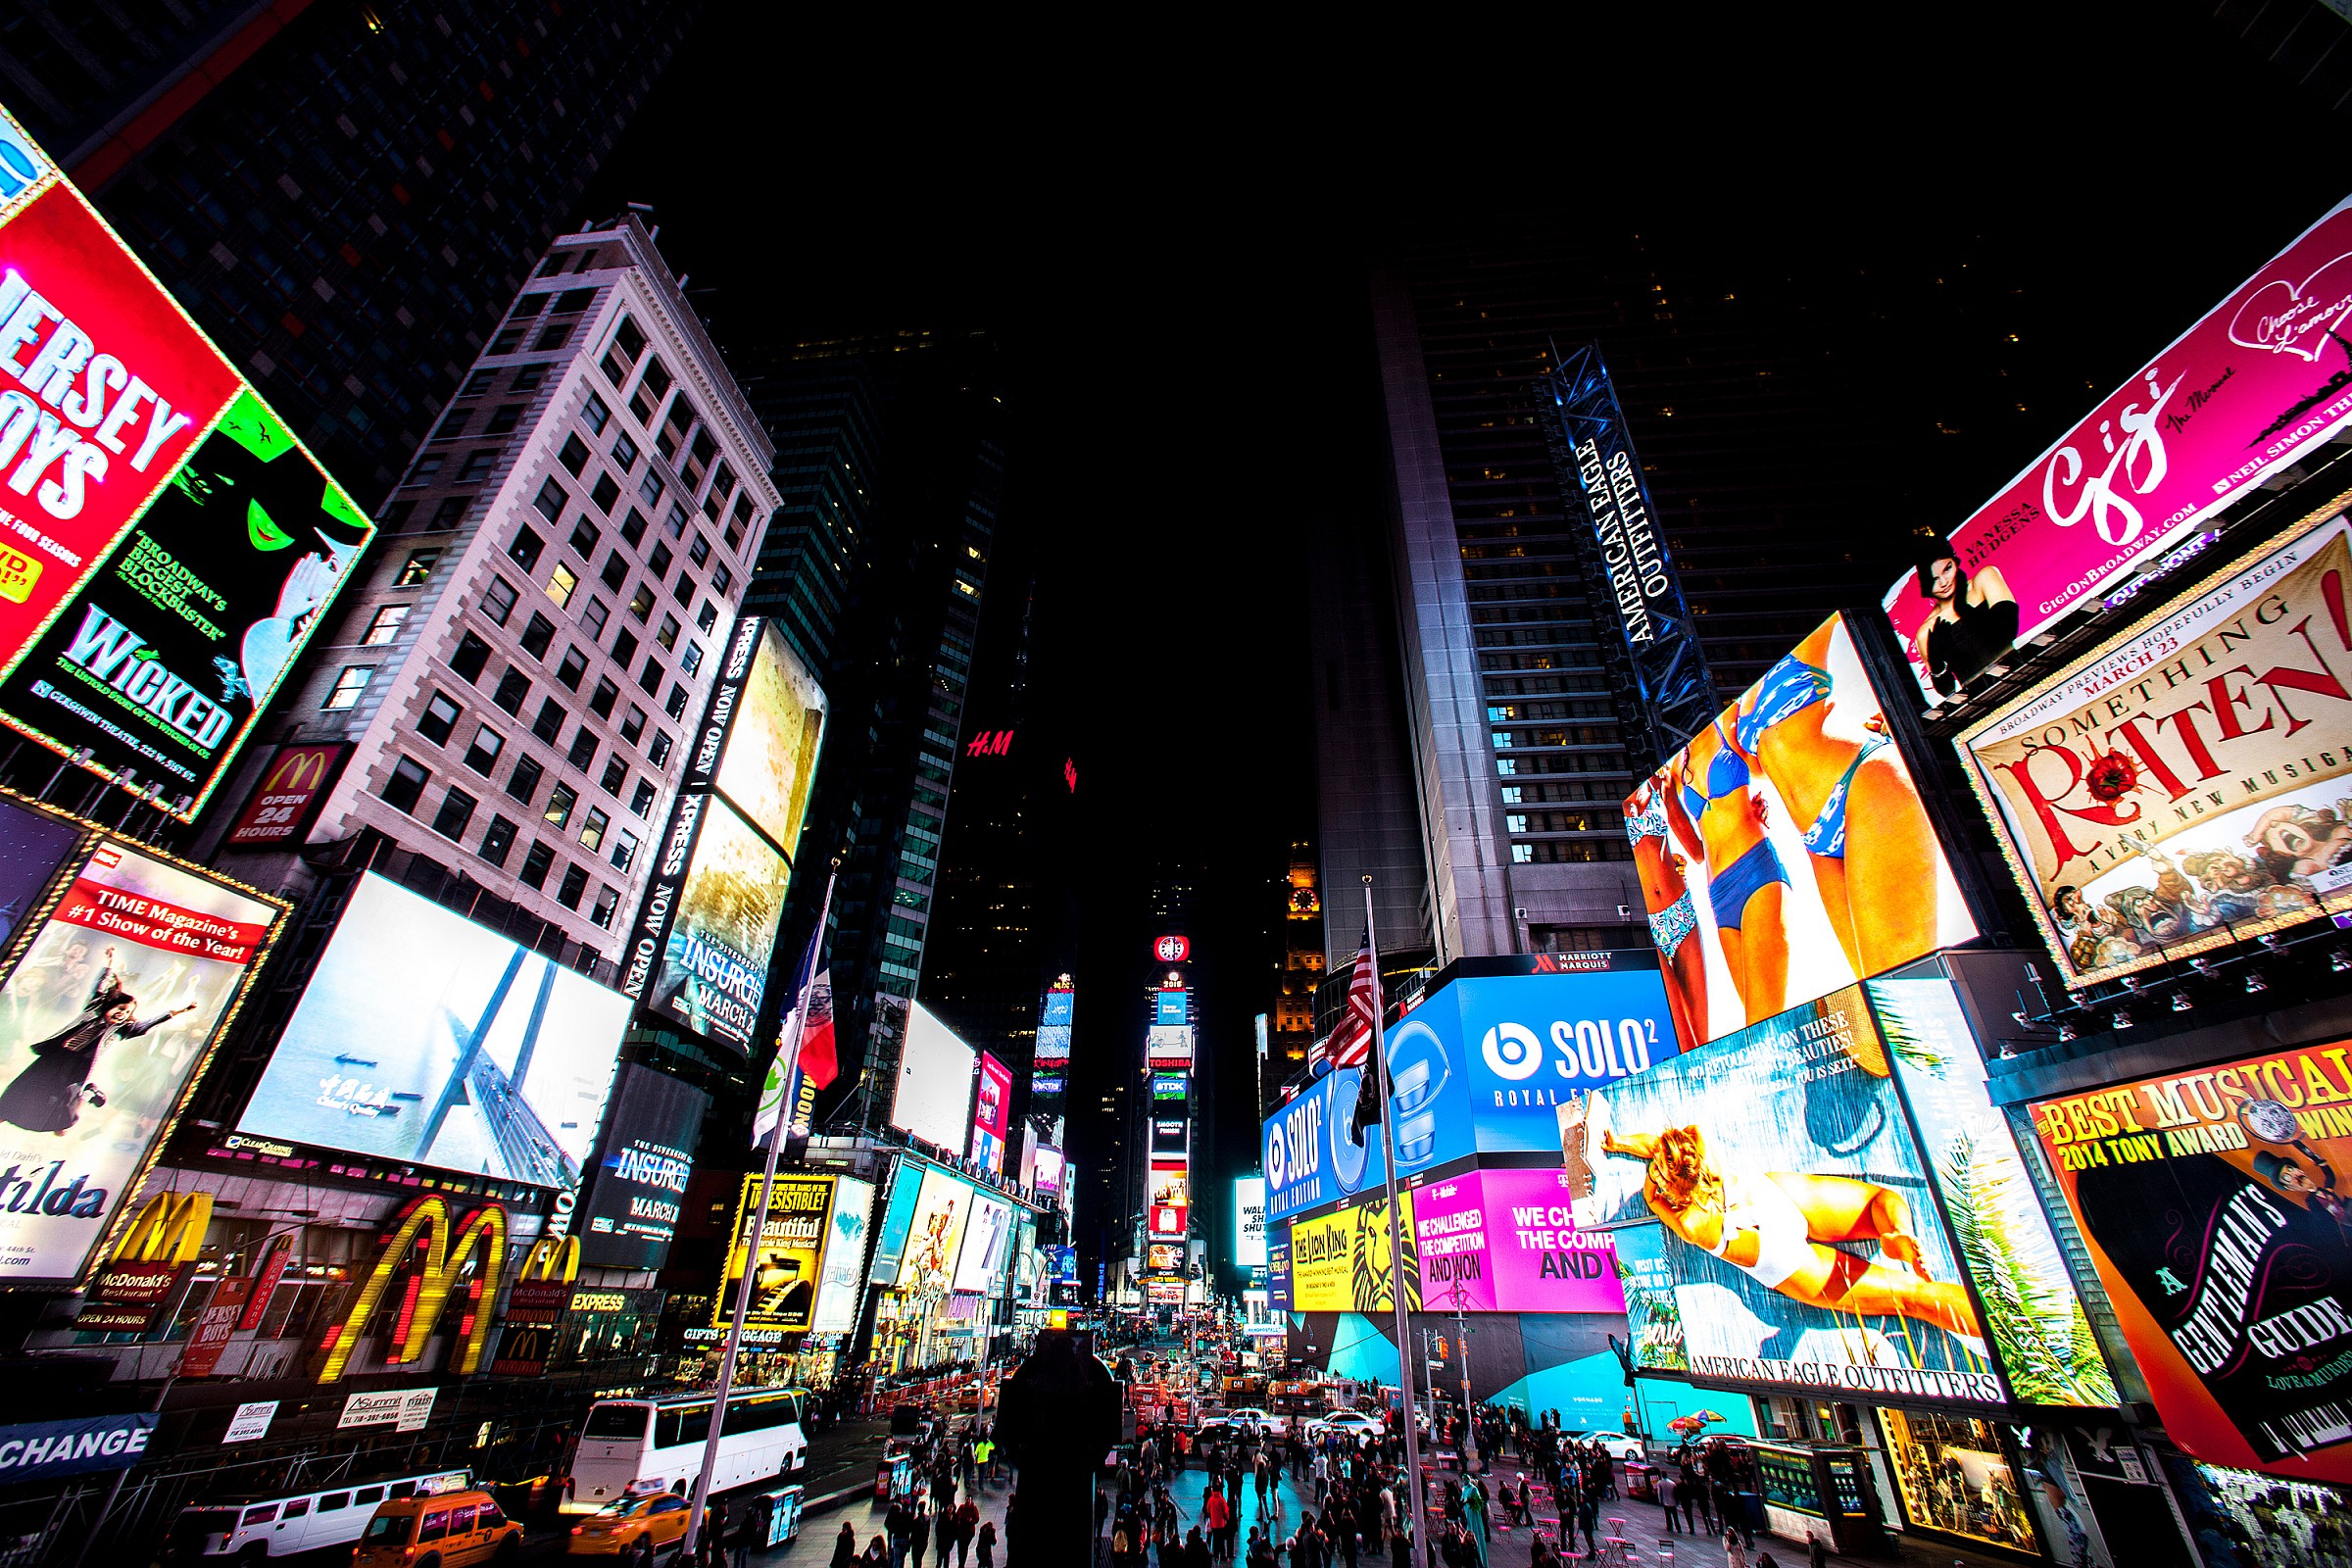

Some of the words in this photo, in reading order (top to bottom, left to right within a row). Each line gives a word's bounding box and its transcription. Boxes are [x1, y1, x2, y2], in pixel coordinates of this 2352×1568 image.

[2256, 296, 2320, 343] Choose
[2165, 413, 2192, 434] The
[2229, 457, 2269, 484] NEIL
[2267, 416, 2325, 458] SIMON
[1575, 438, 1612, 514] EAGLE
[1606, 451, 1668, 599] OUTFITTERS
[1965, 502, 2033, 556] VANESSA
[1968, 507, 2040, 568] HUDGENS
[37, 535, 81, 568] SEASONS
[127, 546, 193, 599] BIGGEST
[1595, 510, 1653, 644] AMERICAN
[2000, 692, 2063, 736] BROADWAY
[2067, 648, 2138, 694] PREVIEWS
[2141, 583, 2239, 651] HOPEFULLY
[2239, 552, 2299, 590] BEGIN
[2021, 594, 2290, 756] SOMETHING
[2083, 650, 2155, 699] MARCH
[2158, 636, 2180, 659] 23
[49, 691, 102, 724] GERSHWIN
[712, 684, 737, 727] NOW
[695, 727, 723, 776] OPEN
[967, 730, 1013, 757] H&M
[253, 807, 294, 824] 24
[261, 794, 308, 806] OPEN
[235, 825, 296, 838] HOURS
[2089, 859, 2100, 874] A
[2173, 790, 2226, 822] NEW
[97, 889, 148, 915] TIME
[150, 905, 239, 941] Magazine's
[645, 883, 673, 937] NOW
[67, 904, 95, 921] #1
[97, 912, 149, 937] Show
[151, 927, 172, 942] of
[172, 930, 200, 948] the
[204, 938, 245, 959] Year!
[624, 938, 656, 1000] OPEN
[1559, 953, 1612, 961] MARRIOTT
[1560, 961, 1608, 970] MARQUIS
[698, 985, 750, 1030] MARCH
[1779, 1029, 1799, 1049] ON
[1799, 1010, 1849, 1040] THESE
[1150, 1058, 1192, 1067] TOSHIBA
[1785, 1029, 1855, 1069] BEAUTIES!
[1794, 1071, 1815, 1084] YOU
[1816, 1065, 1827, 1079] IS
[1494, 1090, 1557, 1107] ROYAL
[2039, 1089, 2144, 1145] BEST
[2057, 1142, 2109, 1171] 2014
[2105, 1133, 2165, 1164] TONY
[2165, 1122, 2249, 1156] AWARD
[630, 1198, 673, 1223] MARCH
[749, 1191, 828, 1210] IRESISTIBLE!
[744, 1215, 821, 1238] Bautiful
[1418, 1218, 1430, 1237] WE
[1430, 1208, 1482, 1235] CHALLENGED
[1512, 1206, 1544, 1227] WE
[1296, 1238, 1307, 1259] THE
[1307, 1229, 1325, 1264] LION
[1326, 1224, 1348, 1262] KING
[1420, 1239, 1435, 1256] THE
[1434, 1232, 1485, 1255] COMPETITION
[1516, 1231, 1560, 1250] THE
[96, 1274, 172, 1288] McDonald's
[1429, 1256, 1450, 1282] AND
[1449, 1252, 1481, 1280] WON
[1540, 1251, 1602, 1280] AND
[2172, 1183, 2287, 1374] GENTLEMAN'S
[513, 1289, 567, 1298] McDonald's
[2156, 1267, 2189, 1296] A
[202, 1304, 244, 1325] JERSEY
[570, 1294, 625, 1310] EXPRESS
[77, 1314, 102, 1323] OPEN
[102, 1315, 116, 1324] 24
[115, 1315, 147, 1325] HOURS
[200, 1324, 232, 1343] BOYS
[684, 1328, 720, 1340] GIFTS
[726, 1330, 782, 1343] LGGAGE
[1691, 1355, 1775, 1382] AMERICAN
[1779, 1360, 1840, 1387] EAGLE
[1844, 1365, 2001, 1402] OUTFITTERS
[2266, 1375, 2303, 1391] LOVE
